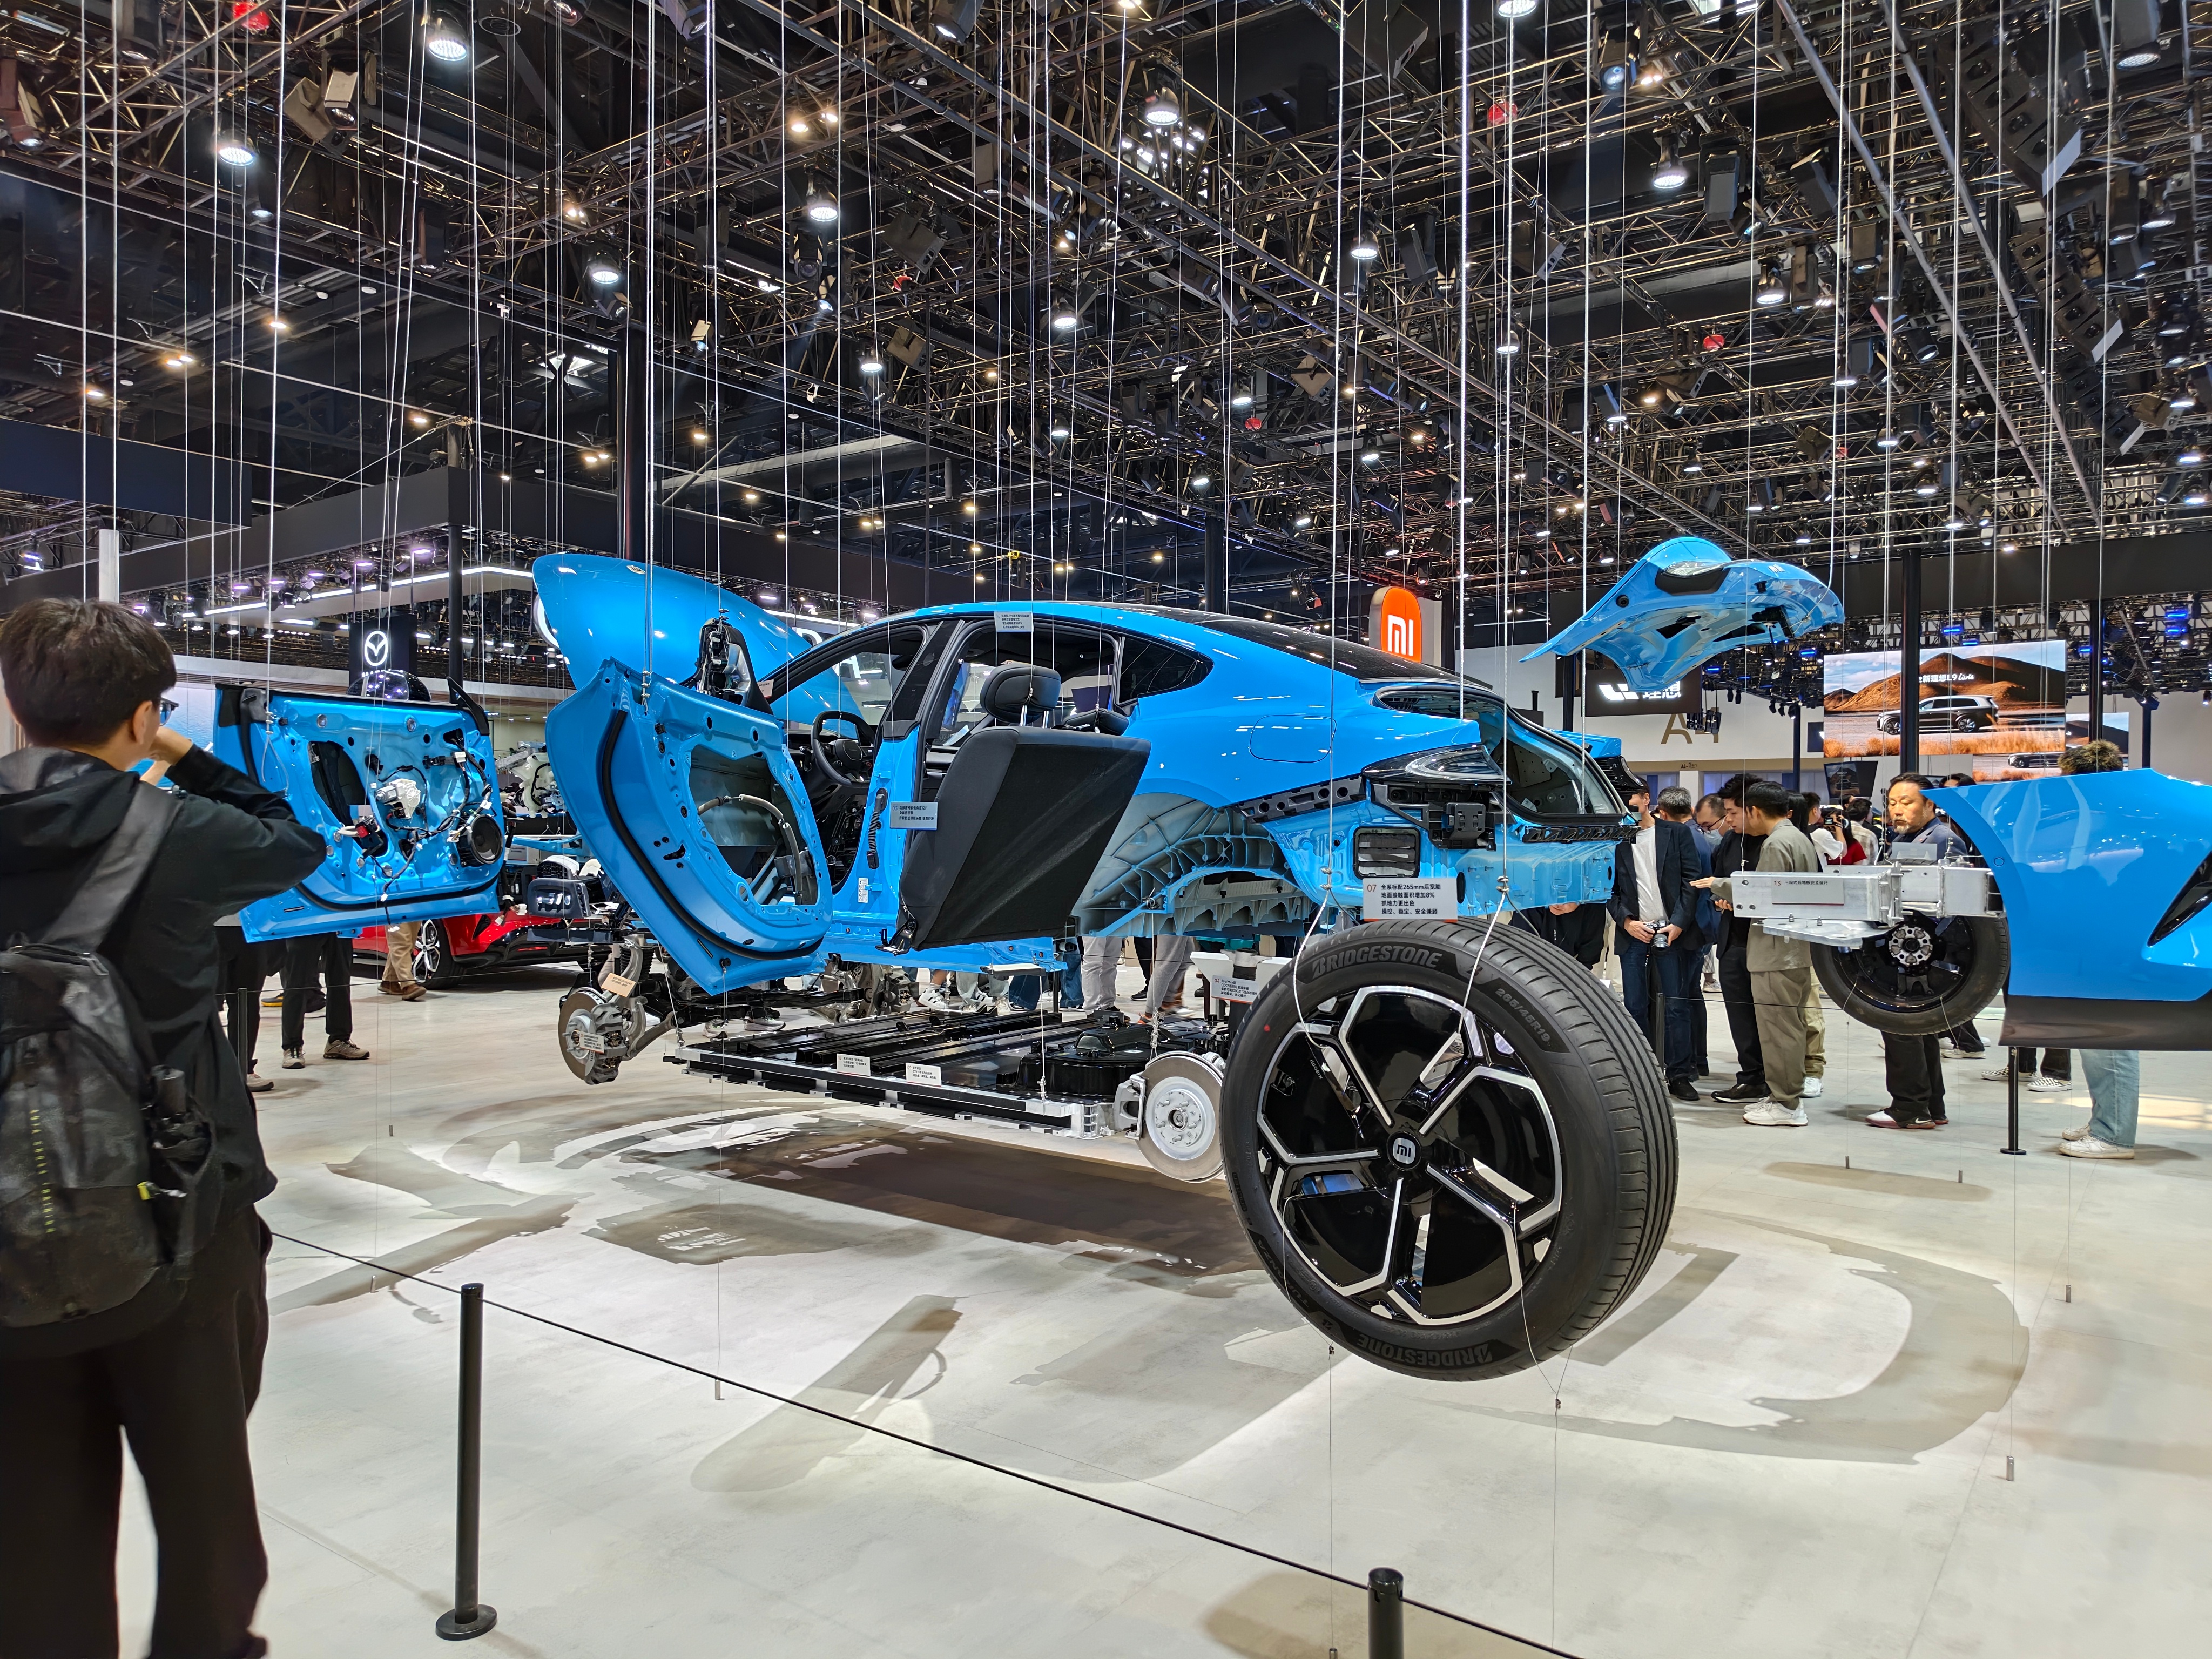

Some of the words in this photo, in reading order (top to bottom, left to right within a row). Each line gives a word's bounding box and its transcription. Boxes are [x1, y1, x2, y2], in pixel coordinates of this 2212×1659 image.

[1312, 945, 1443, 979] BRIDGESTONE
[1495, 988, 1550, 1042] 265/45R19
[1310, 1059, 1323, 1080] xiaomi
[1358, 1333, 1493, 1367] BRIDGESTONE
